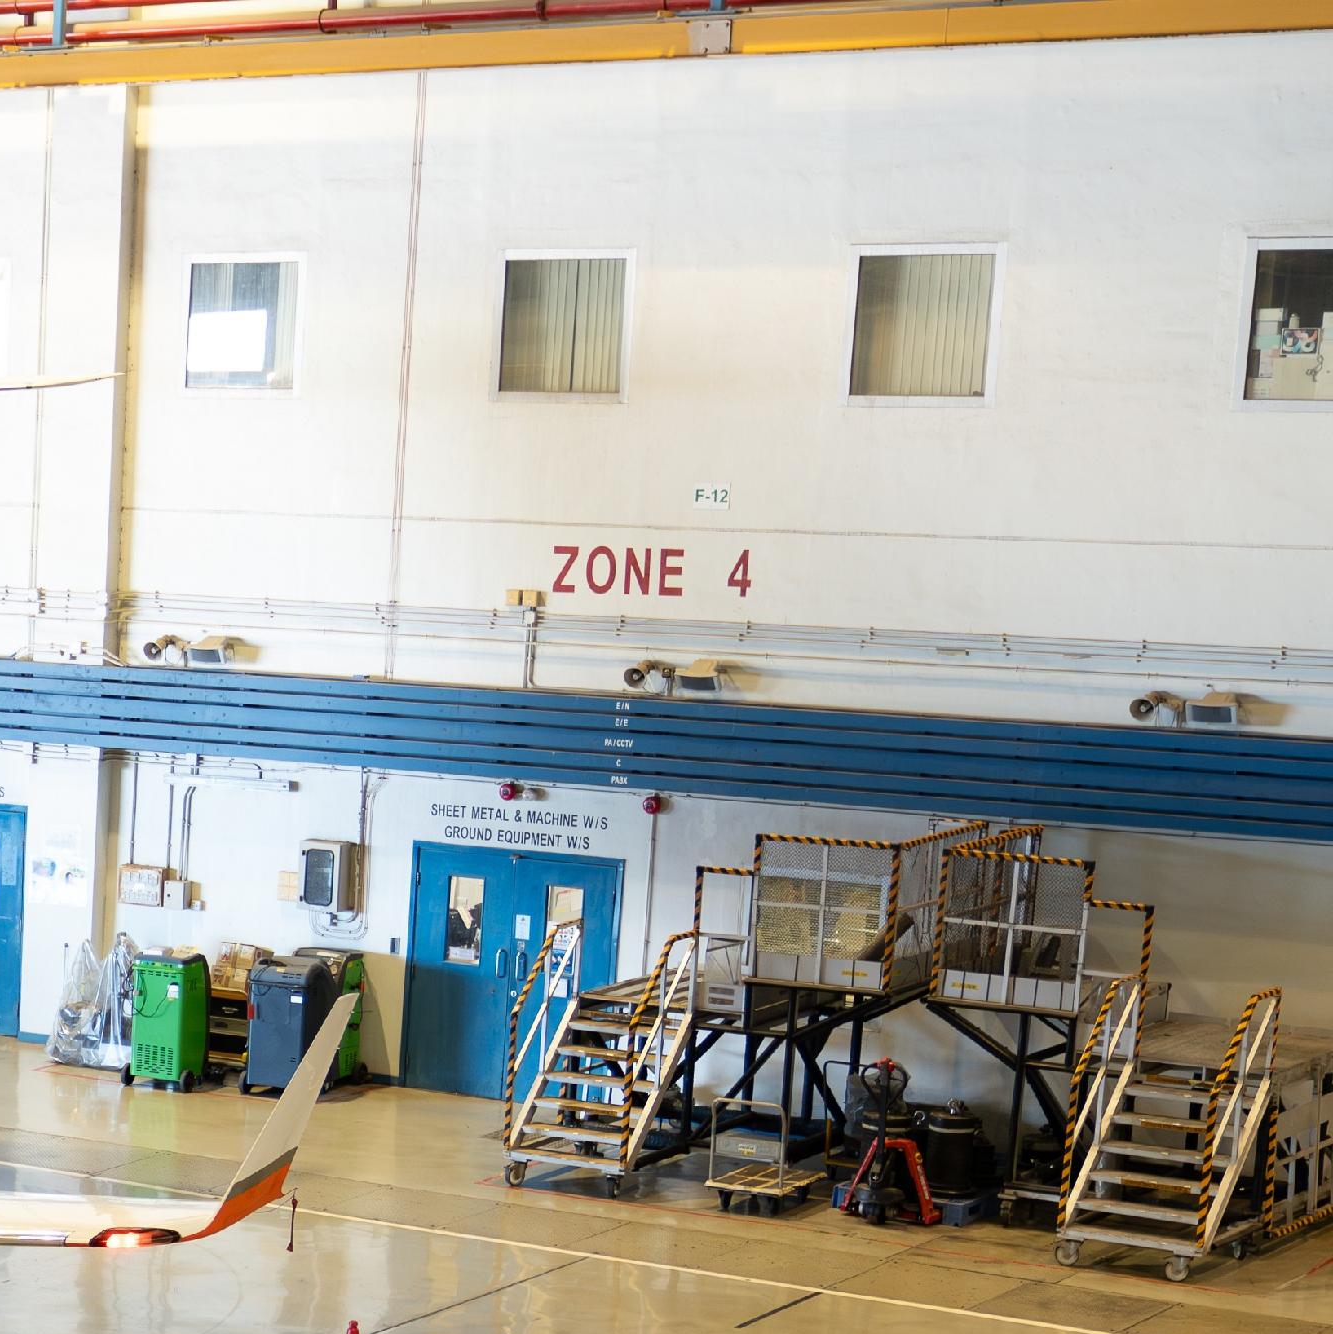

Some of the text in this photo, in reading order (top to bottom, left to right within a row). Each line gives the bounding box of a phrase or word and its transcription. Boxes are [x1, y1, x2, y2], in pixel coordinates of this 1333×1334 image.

[694, 488, 729, 504] F-12
[552, 545, 752, 598] ZONE 4
[604, 738, 634, 749] PA/CCTV
[615, 758, 622, 767] C
[430, 803, 608, 830] SHEET METAL & MACHINE W/S
[444, 825, 591, 850] GROUND EQUIPMENT W/S
